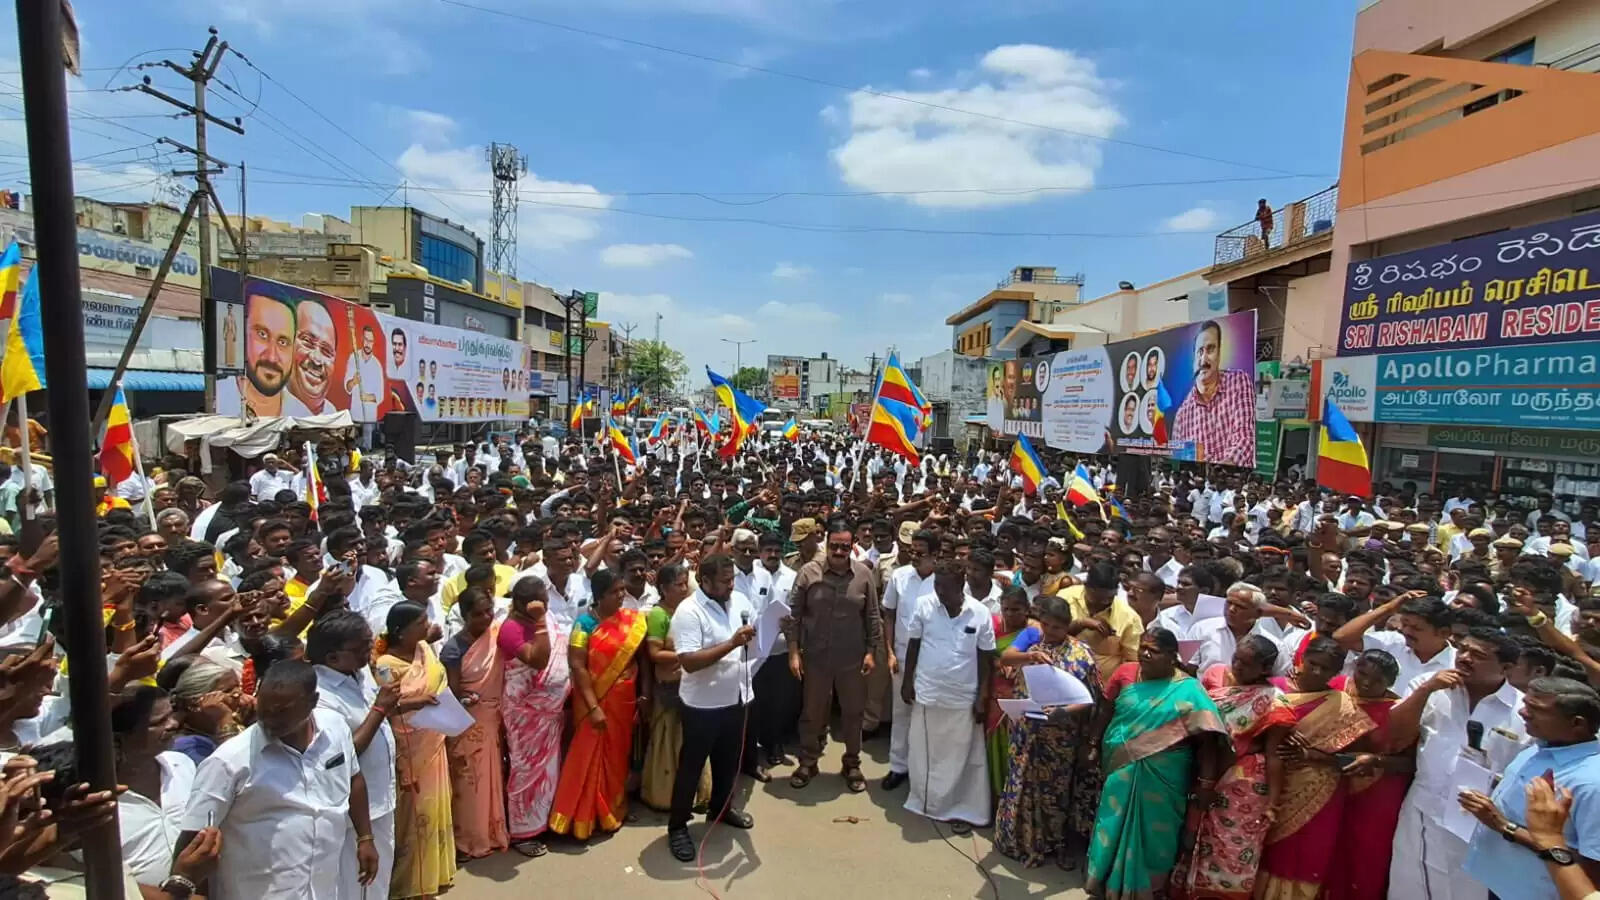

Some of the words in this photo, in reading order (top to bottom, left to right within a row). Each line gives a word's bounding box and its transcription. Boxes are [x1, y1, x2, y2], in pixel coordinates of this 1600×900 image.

[1345, 324, 1374, 349] SRI
[1377, 312, 1488, 347] RISHABAM
[1501, 299, 1600, 337] RESIDE
[1328, 386, 1367, 403] Apollo
[1382, 389, 1502, 406] அப்போலோ
[1511, 388, 1600, 411] மருந்த
